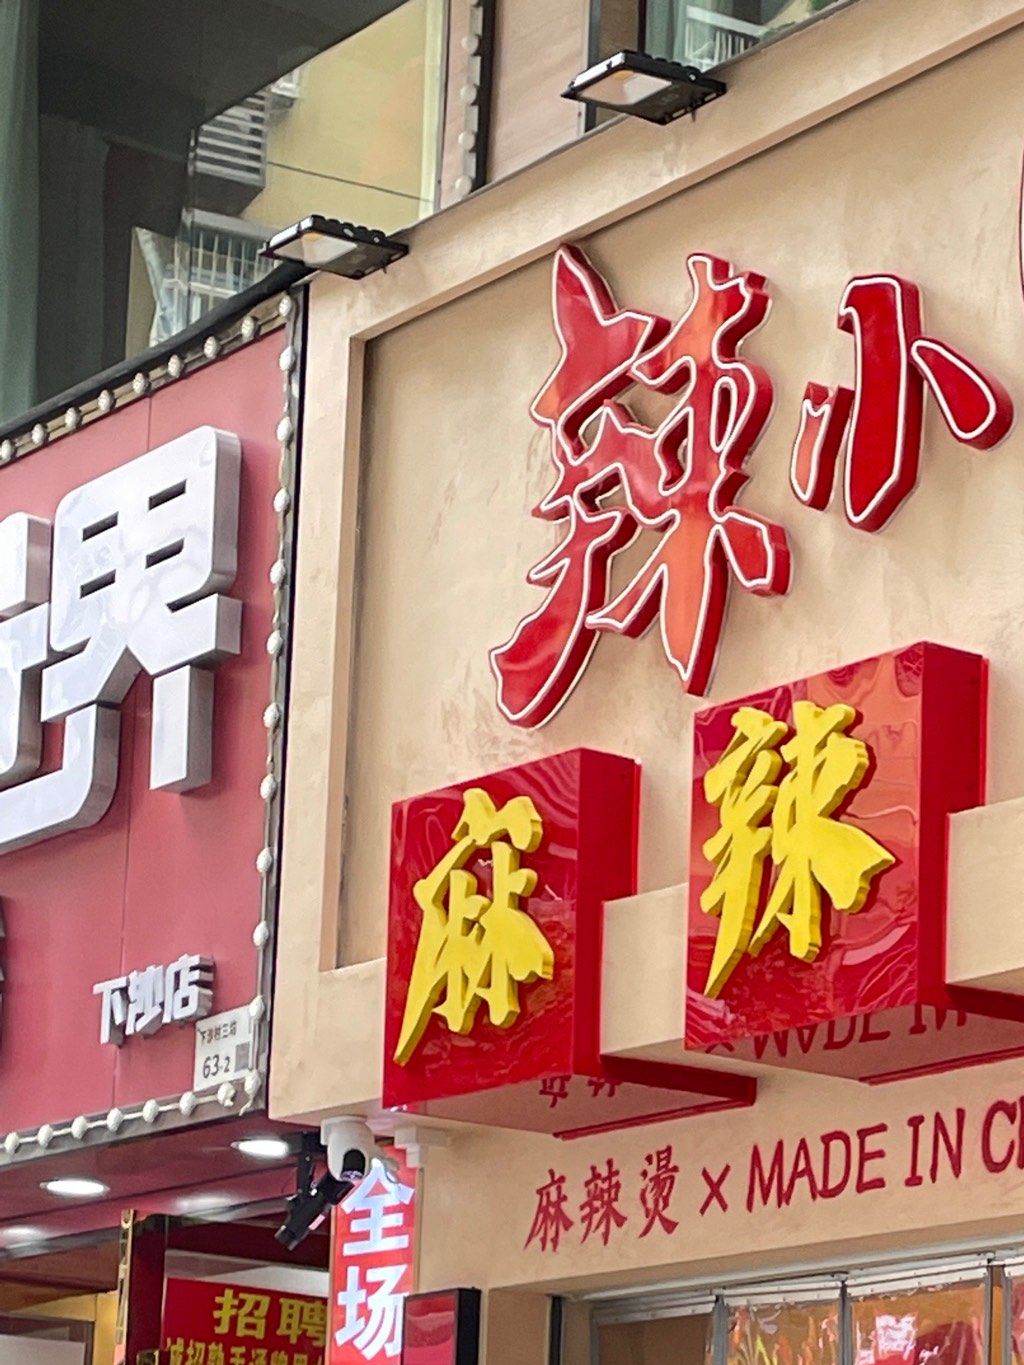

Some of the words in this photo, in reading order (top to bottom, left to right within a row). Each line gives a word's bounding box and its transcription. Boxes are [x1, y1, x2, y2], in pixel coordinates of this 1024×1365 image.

[94, 953, 214, 1046] 下沙店
[203, 1053, 231, 1080] 63-2
[746, 1121, 889, 1214] MADE
[904, 1106, 967, 1188] IN
[213, 1288, 328, 1348] 招聘
